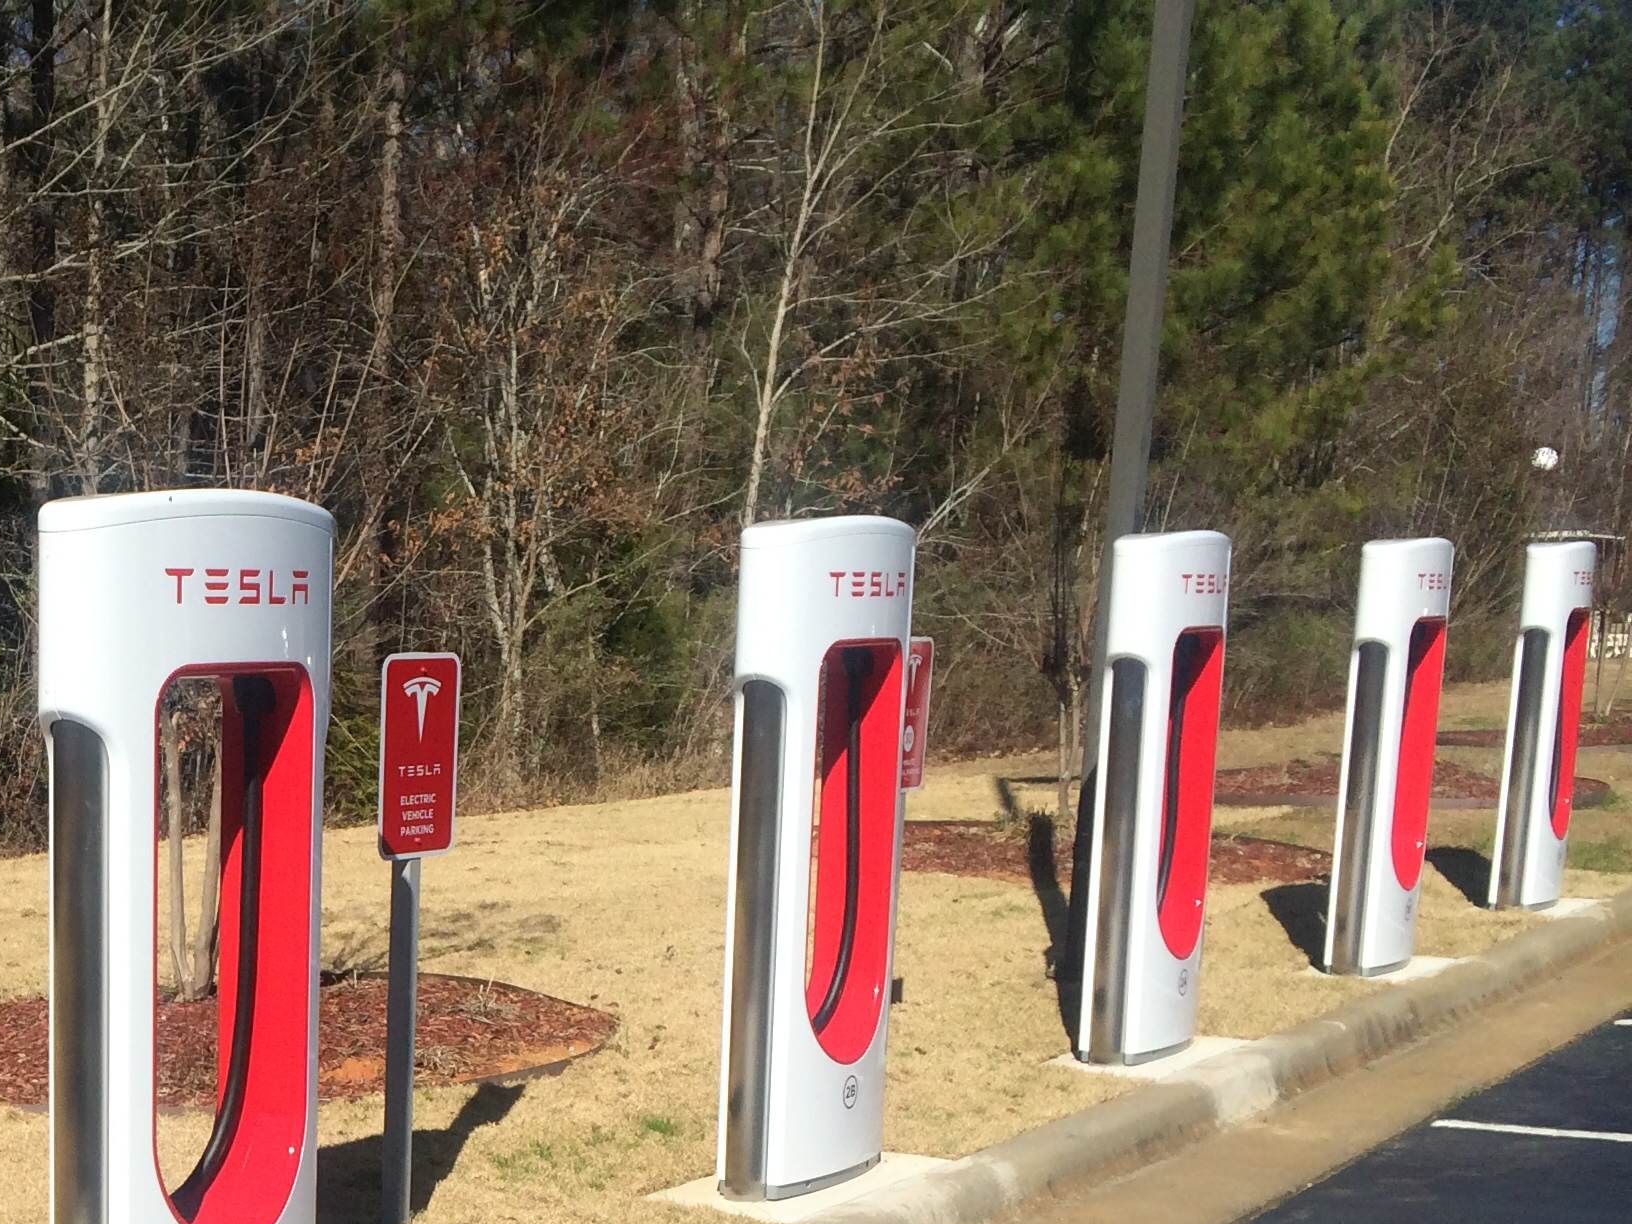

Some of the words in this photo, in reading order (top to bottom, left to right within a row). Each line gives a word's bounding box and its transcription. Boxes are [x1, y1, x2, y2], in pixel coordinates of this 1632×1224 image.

[164, 567, 309, 605] TESLA
[829, 571, 906, 597] TESLA
[398, 763, 441, 777] TESLA
[400, 793, 436, 806] ELECTRIC
[401, 808, 434, 821] VEHICLE
[400, 823, 434, 837] PARKING
